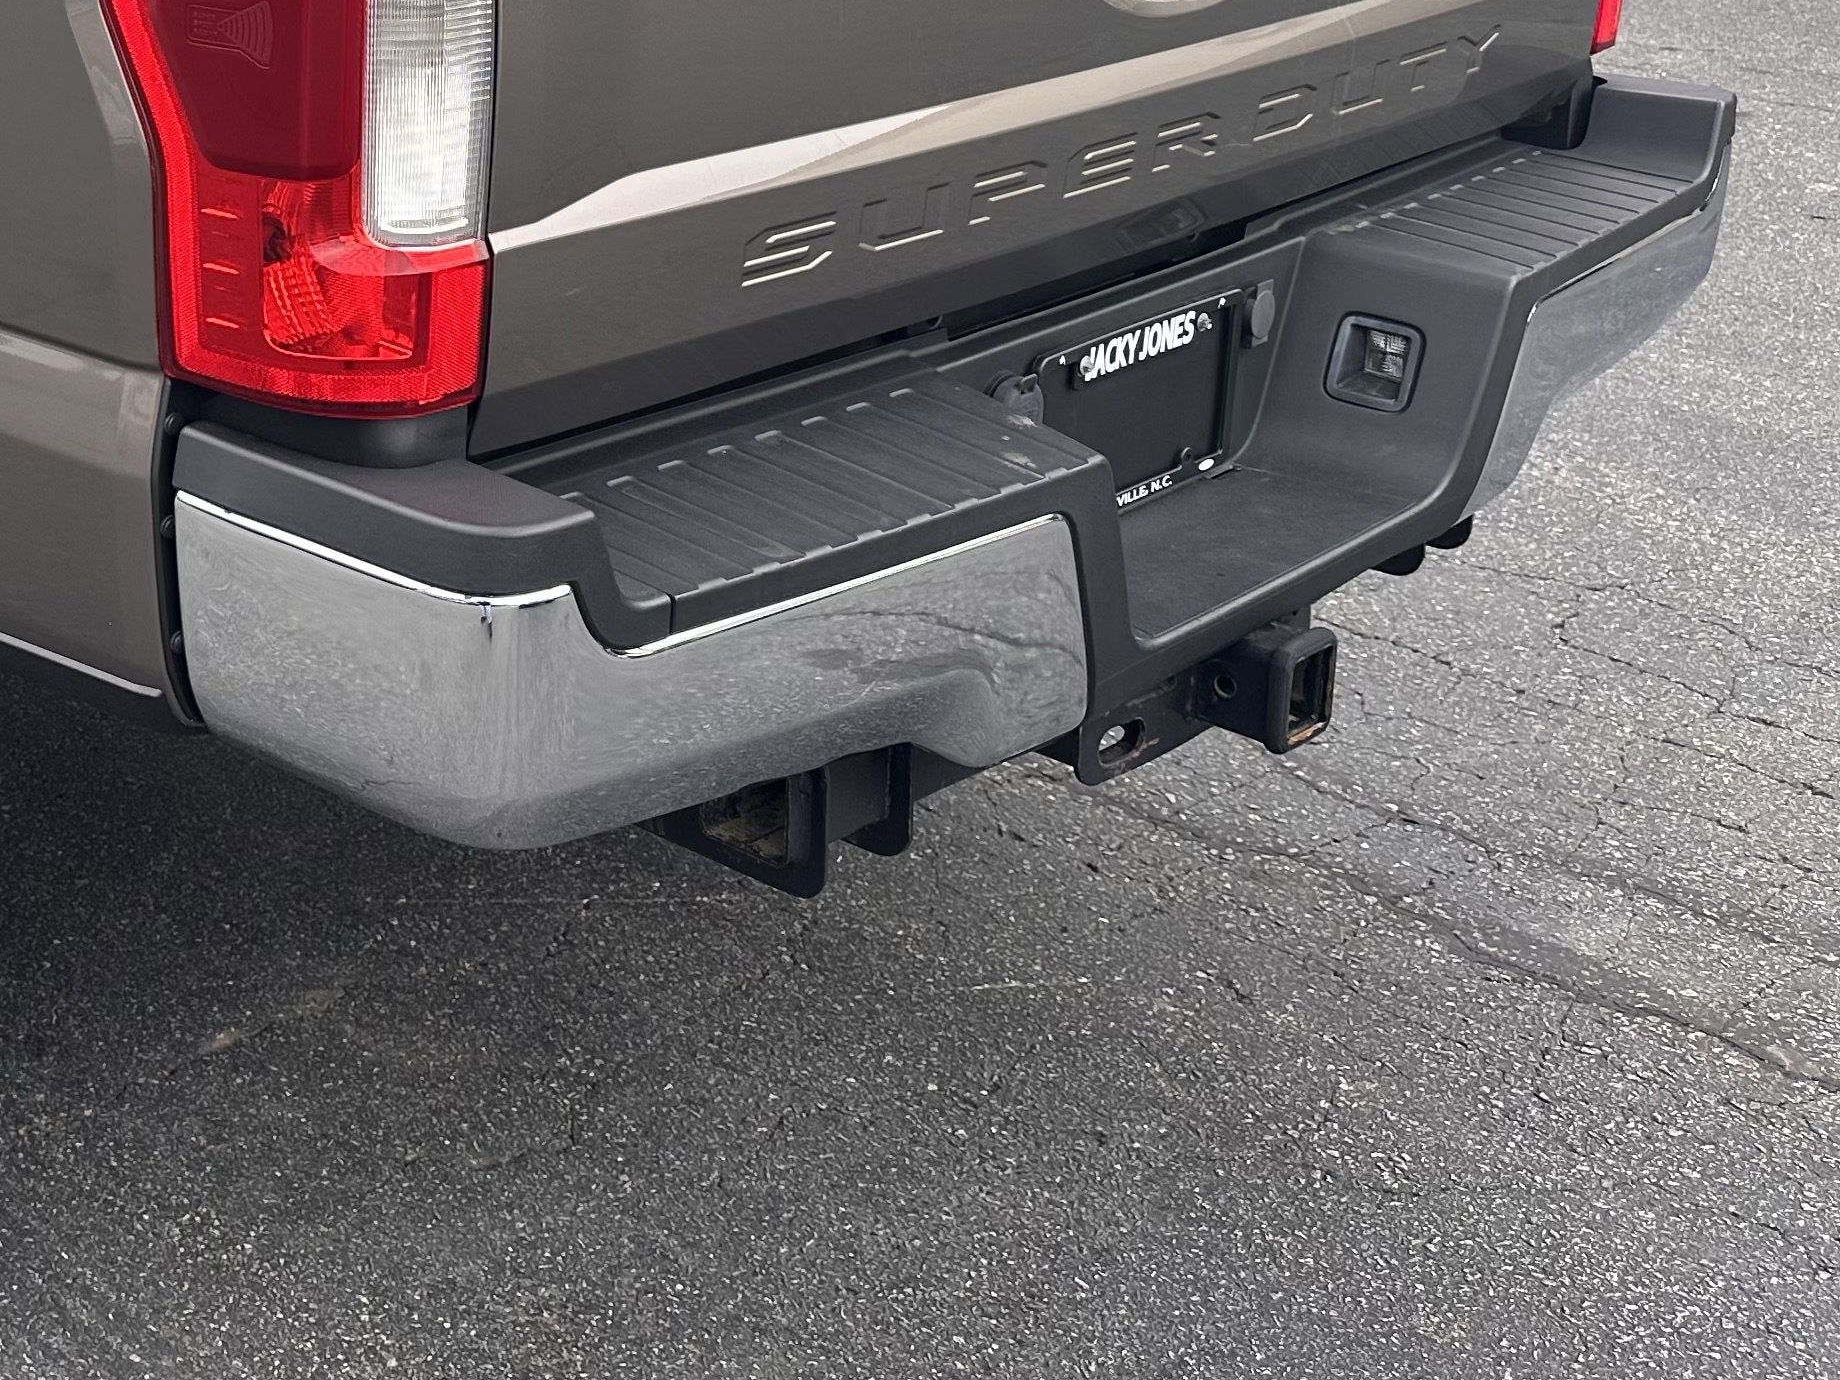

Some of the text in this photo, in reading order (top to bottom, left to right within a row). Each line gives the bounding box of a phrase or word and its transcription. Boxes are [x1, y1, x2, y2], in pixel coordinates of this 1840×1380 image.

[740, 23, 1503, 289] SUPER DUTY
[1084, 310, 1196, 383] JACKY JONES
